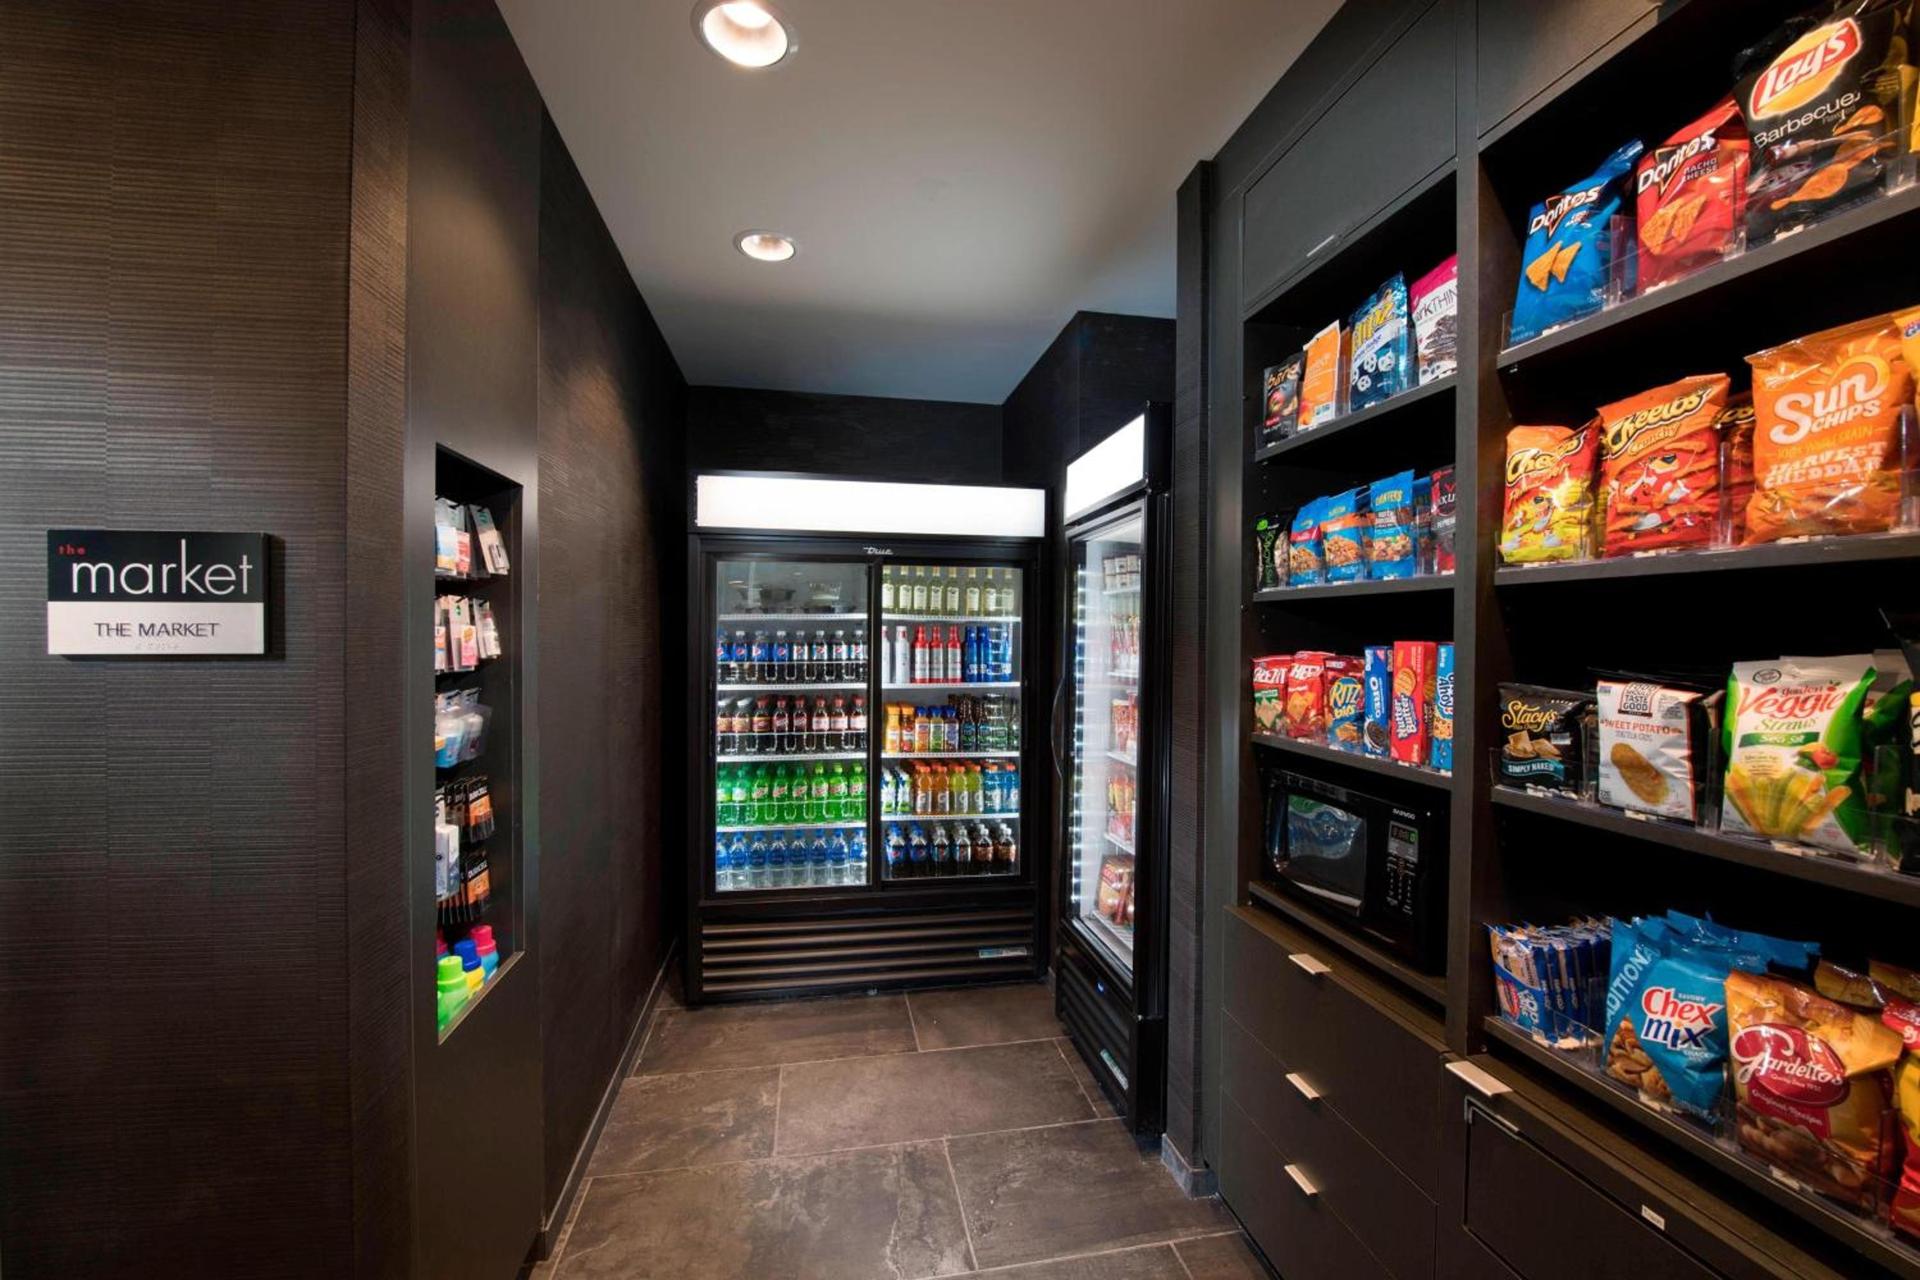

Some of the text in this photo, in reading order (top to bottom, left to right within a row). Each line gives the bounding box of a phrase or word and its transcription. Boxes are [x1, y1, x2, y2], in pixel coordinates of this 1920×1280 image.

[1754, 91, 1856, 149] Barbecue
[1638, 128, 1716, 194] Doritos
[1683, 165, 1718, 182] HEESE
[1529, 183, 1604, 235] Doritos
[1607, 390, 1706, 453] Cheetos
[1770, 373, 1870, 444] Sun
[1811, 400, 1882, 433] CHIPS
[1769, 441, 1888, 477] HARVEST
[58, 544, 87, 555] the
[71, 538, 253, 595] market
[94, 622, 220, 637] THE MARKET
[1330, 681, 1362, 709] RITZ
[1370, 676, 1381, 718] OREO
[1623, 702, 1649, 712] GOOD
[1625, 694, 1649, 704] TASTE
[1737, 687, 1846, 719] Veggie
[1632, 722, 1670, 734] POTATO
[1508, 763, 1555, 773] SIMPLY NAKED
[1643, 987, 1720, 1026] Chex
[1642, 1018, 1712, 1050] mix
